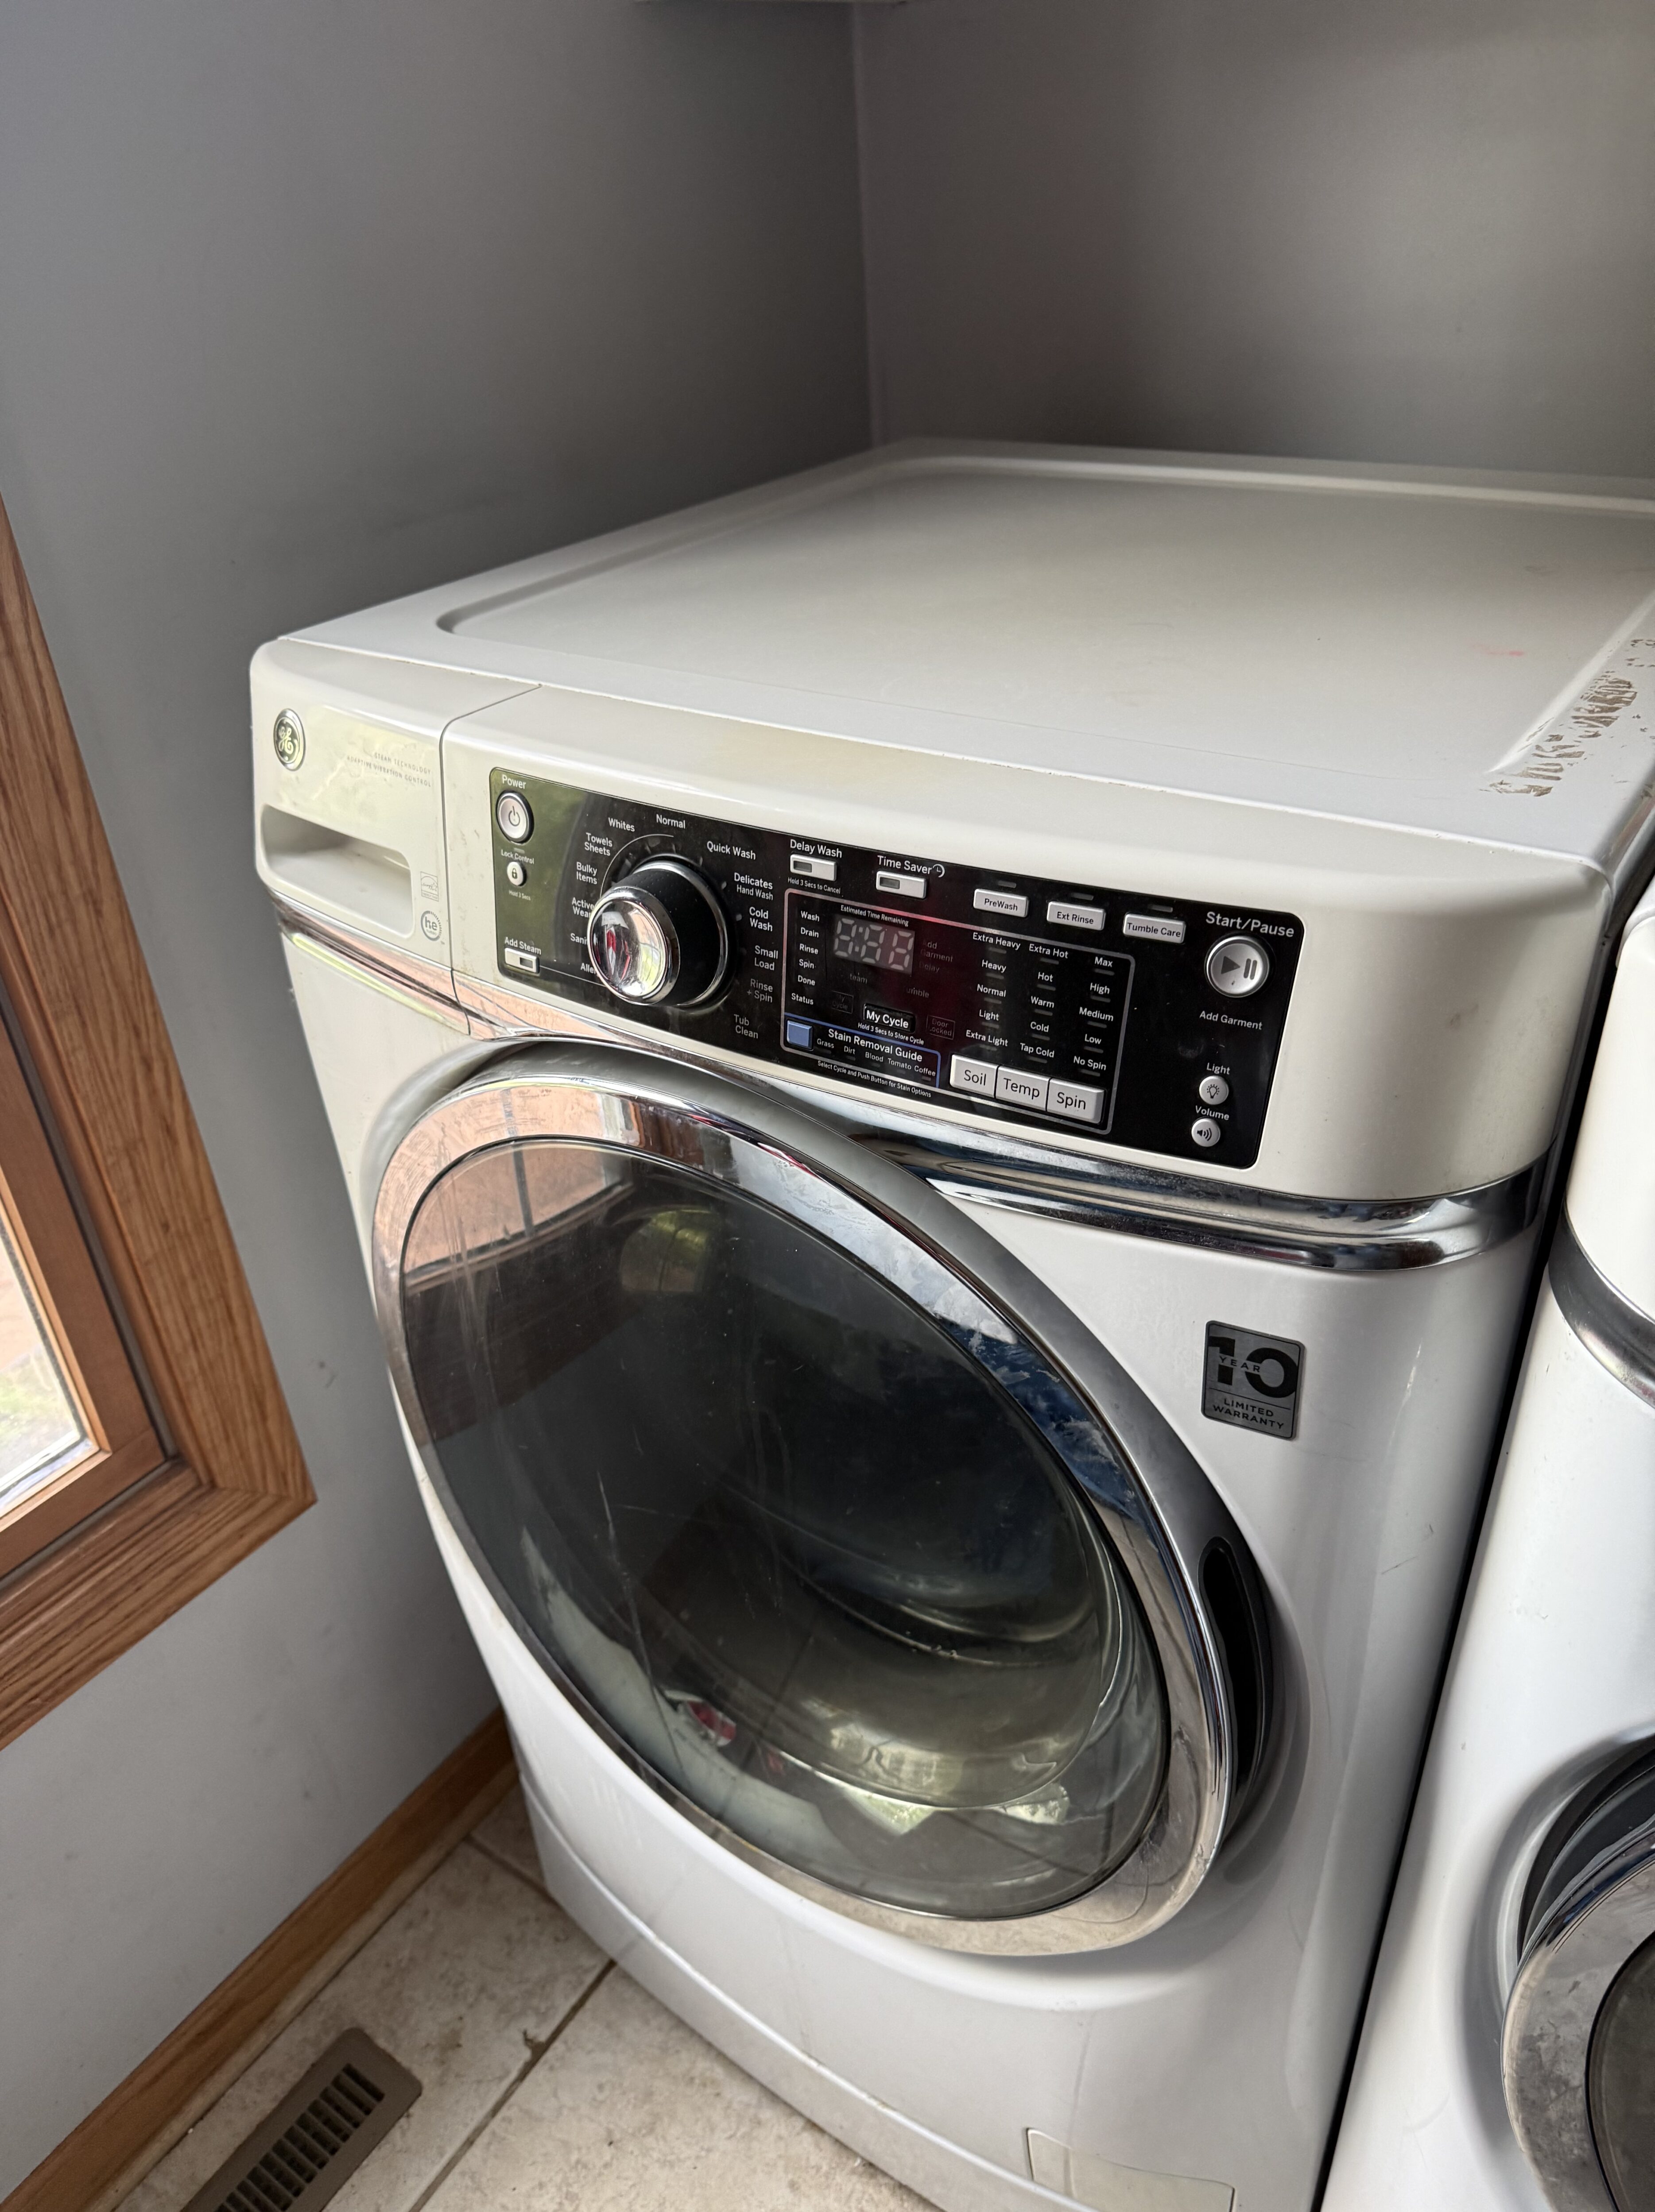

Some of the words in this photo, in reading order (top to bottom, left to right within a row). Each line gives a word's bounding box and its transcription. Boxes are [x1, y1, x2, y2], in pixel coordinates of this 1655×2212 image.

[374, 752, 392, 763] STEAM
[394, 758, 431, 775] TECHNOLOGY
[404, 774, 431, 788] CONTROL
[502, 774, 527, 790] Power
[608, 817, 636, 832] Whites
[656, 814, 686, 829] Normal
[586, 832, 613, 848] Towels
[501, 849, 514, 859] Lock
[514, 854, 535, 864] Control
[585, 842, 611, 857] Sheets
[707, 841, 731, 855] Quick
[733, 846, 756, 860] Wash
[790, 839, 815, 855] Delay
[817, 844, 842, 859] Wash
[576, 862, 597, 877] Bulky
[877, 855, 901, 869] Time
[904, 860, 933, 875] Saver
[576, 871, 597, 885] Items
[734, 872, 773, 889] Delicates
[788, 877, 799, 885] Hold
[824, 885, 841, 894] Cancel
[736, 884, 754, 896] Hand
[755, 889, 773, 901] Wash
[572, 897, 594, 910] Active
[984, 898, 1018, 911] PreWash
[749, 906, 769, 919] Cold
[801, 911, 820, 922] Wash
[841, 905, 866, 917] Estimated
[867, 911, 880, 919] Time
[881, 914, 909, 927] Remaining
[1057, 911, 1070, 920] Ext
[1072, 914, 1094, 924] Rinse
[424, 916, 438, 931] he
[750, 917, 773, 932] Wash
[1127, 922, 1159, 934] Tumble
[1160, 928, 1181, 937] Care
[1205, 911, 1294, 937] Start/Pause
[800, 927, 819, 938] Drain
[504, 936, 518, 947] Add
[519, 941, 542, 955] Steam
[973, 932, 993, 944] Extra
[995, 937, 1021, 951] Heavy
[755, 945, 779, 959] Small
[799, 944, 818, 955] Rinse
[1028, 943, 1050, 955] Extra
[1052, 948, 1069, 959] Hot
[754, 957, 775, 971] Load
[798, 959, 815, 969] Spin
[981, 959, 1007, 973] Heavy
[1094, 956, 1113, 967] Max
[798, 975, 816, 986] Done
[1038, 971, 1054, 982] Hot
[750, 978, 774, 992] Rinse
[977, 983, 1007, 997] Normal
[1089, 982, 1110, 994] High
[754, 990, 773, 1003] Spin
[791, 993, 814, 1005] Status
[1031, 996, 1054, 1009] Warm
[733, 1013, 750, 1026] Tub
[866, 1009, 880, 1023] My
[882, 1014, 909, 1029] Cycle
[979, 1009, 1000, 1021] Light
[1079, 1006, 1114, 1022] Medium
[1199, 1010, 1218, 1021] Add
[1221, 1015, 1263, 1030] Garment
[735, 1025, 759, 1039] Clean
[858, 1022, 869, 1031] Hold
[875, 1027, 887, 1035] Secs
[895, 1032, 909, 1041] Store
[909, 1036, 924, 1045] Cycle
[1030, 1021, 1049, 1033] Cold
[817, 1038, 834, 1049] Grass
[828, 1029, 851, 1043] Stain
[854, 1035, 893, 1054] Removal
[895, 1047, 922, 1062] Guide
[966, 1029, 986, 1041] Extra
[988, 1035, 1008, 1047] Light
[1085, 1034, 1101, 1044] Low
[844, 1045, 856, 1055] Dirt
[865, 1052, 884, 1063] Blood
[1020, 1043, 1034, 1054] Tap
[1036, 1046, 1054, 1058] Cold
[888, 1057, 912, 1070] Tomato
[914, 1065, 936, 1077] Coffee
[1074, 1056, 1085, 1065] No
[1087, 1059, 1106, 1071] Spin
[1206, 1062, 1230, 1075] Light
[818, 1060, 833, 1070] Select
[833, 1065, 847, 1074] Cycle
[857, 1071, 870, 1081] Push
[871, 1075, 888, 1086] Button
[897, 1082, 911, 1092] Stain
[911, 1087, 931, 1098] Options
[964, 1070, 986, 1086] Soil
[1004, 1078, 1040, 1100] Temp
[1056, 1091, 1086, 1110] Spin
[1195, 1105, 1229, 1121] Volume
[1207, 1336, 1298, 1398] 10
[1219, 1355, 1261, 1373] YEAR
[1223, 1398, 1274, 1417] LIMITED
[1213, 1404, 1284, 1429] WARRANTY
